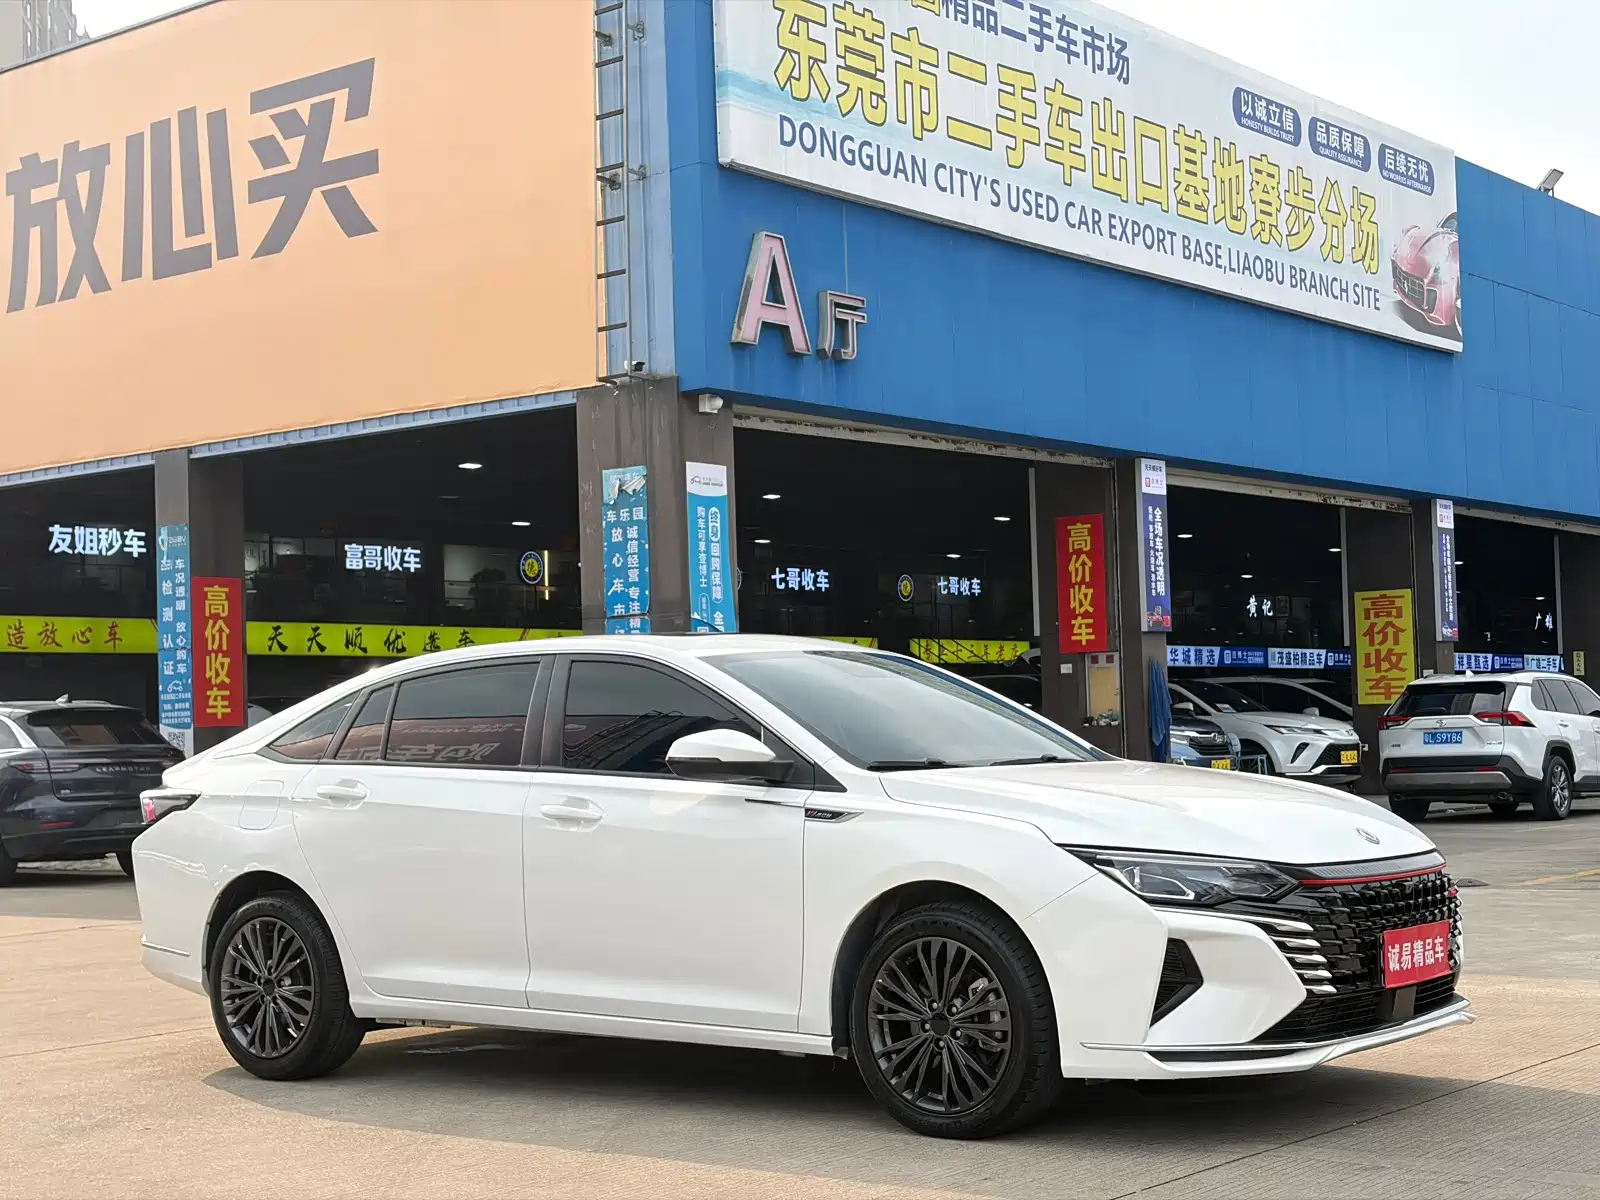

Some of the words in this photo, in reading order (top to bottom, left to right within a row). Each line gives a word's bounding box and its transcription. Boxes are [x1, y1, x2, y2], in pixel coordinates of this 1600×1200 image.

[1240, 91, 1294, 133] 以诚立信
[1241, 117, 1263, 131] HONESTY
[1280, 130, 1294, 143] TRUST
[774, 0, 1380, 275] 东莞市二手车出口基地寮步分场
[1316, 121, 1365, 159] 品质保障
[1319, 147, 1337, 160] QUALITY
[6, 57, 380, 313] 放心买
[1385, 148, 1429, 183] 后续无忧
[779, 114, 927, 187] DONGGUAN
[934, 163, 1001, 207] CITY'S
[1007, 183, 1059, 223] USED
[1064, 201, 1103, 236] CAR
[1108, 214, 1177, 256] EXPORT
[1289, 264, 1349, 302] BRANCH
[1353, 287, 1380, 311] SITE
[49, 524, 147, 557] 友姐秒车
[344, 544, 421, 572] 富哥收车
[626, 526, 639, 582] 诚信经营
[1153, 507, 1165, 596] 全场车况透明
[175, 558, 185, 611] 车况透明
[611, 527, 625, 634] 放心车市
[771, 567, 829, 592] 七哥收车
[937, 576, 981, 596] 七哥收车
[1066, 522, 1097, 646] 高价收车
[1246, 595, 1274, 618] 黄记
[7, 619, 122, 650] 造放心车
[176, 621, 187, 674] 放心购车
[203, 585, 232, 719] 高价收车
[1361, 593, 1407, 700] 高价收车
[1170, 648, 1215, 665] 华城精选
[1388, 936, 1444, 972] 诚易精品车
